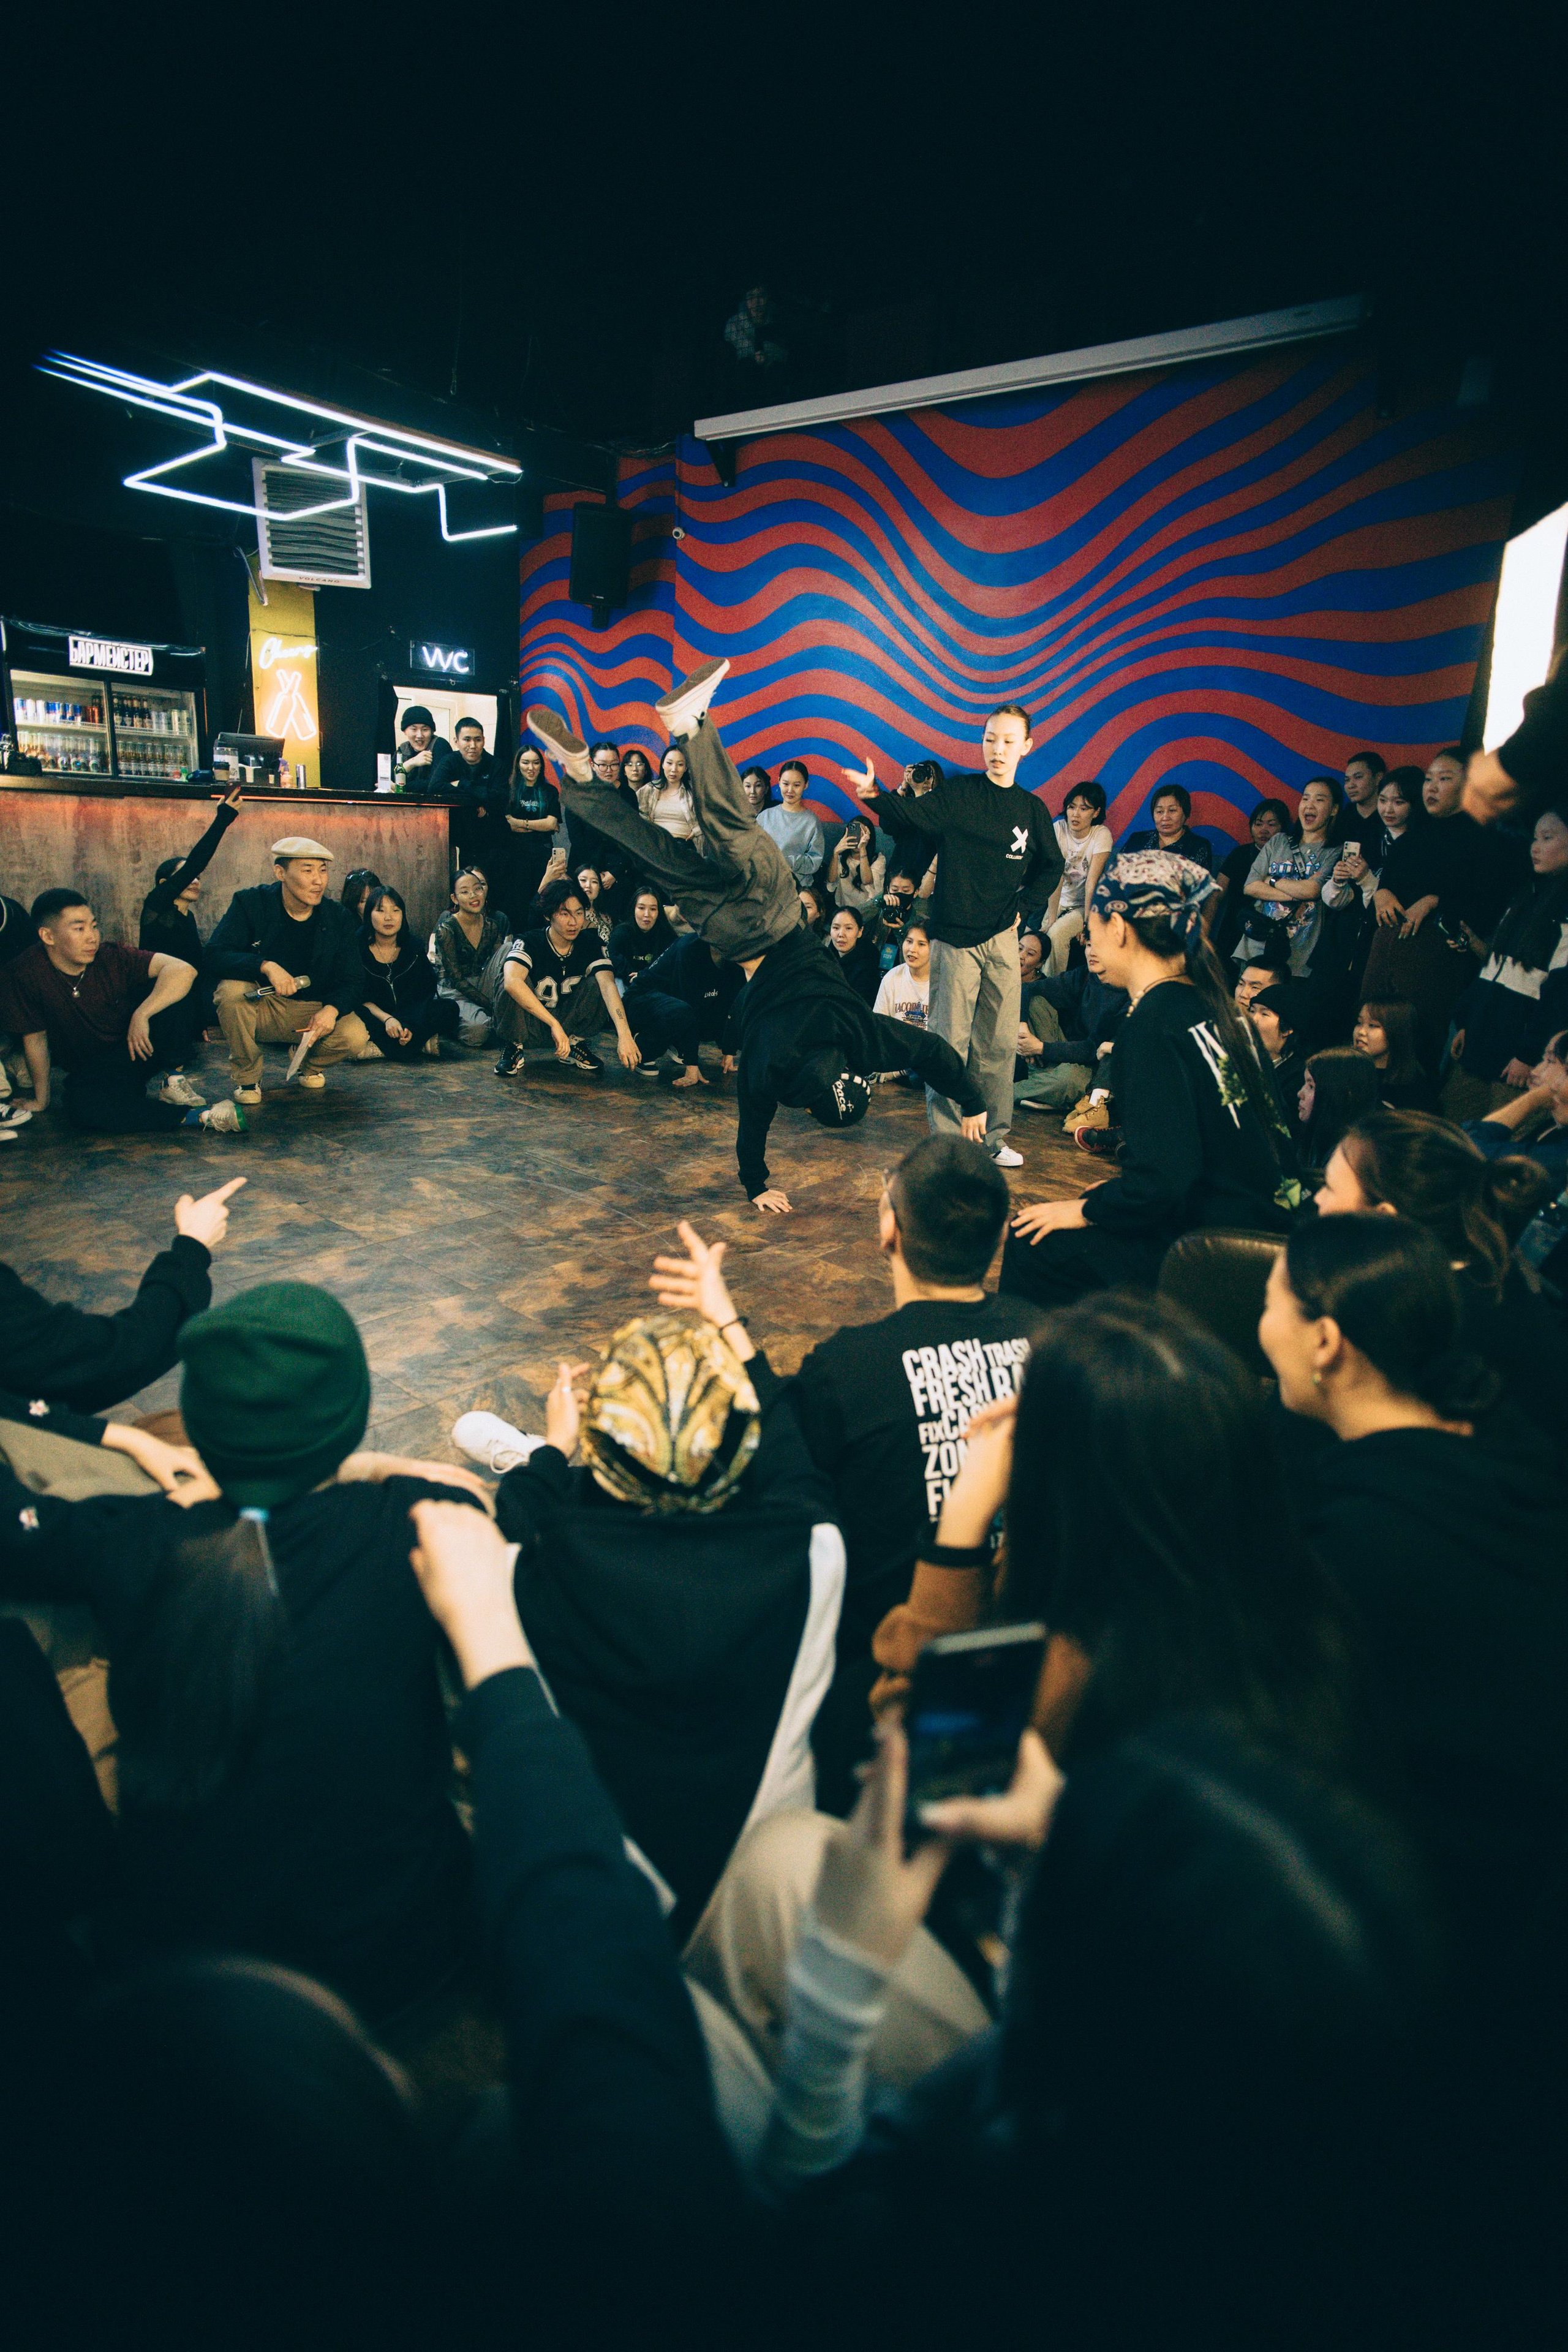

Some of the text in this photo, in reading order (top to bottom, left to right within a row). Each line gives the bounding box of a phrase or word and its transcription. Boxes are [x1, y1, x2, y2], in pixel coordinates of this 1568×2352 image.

[70, 639, 149, 671] БАРМЕЙСТЕР
[422, 646, 469, 673] WC
[834, 1079, 846, 1112] pace
[902, 1338, 987, 1382] CRASH
[910, 1368, 993, 1417] FRESH
[918, 1420, 946, 1445] FIX
